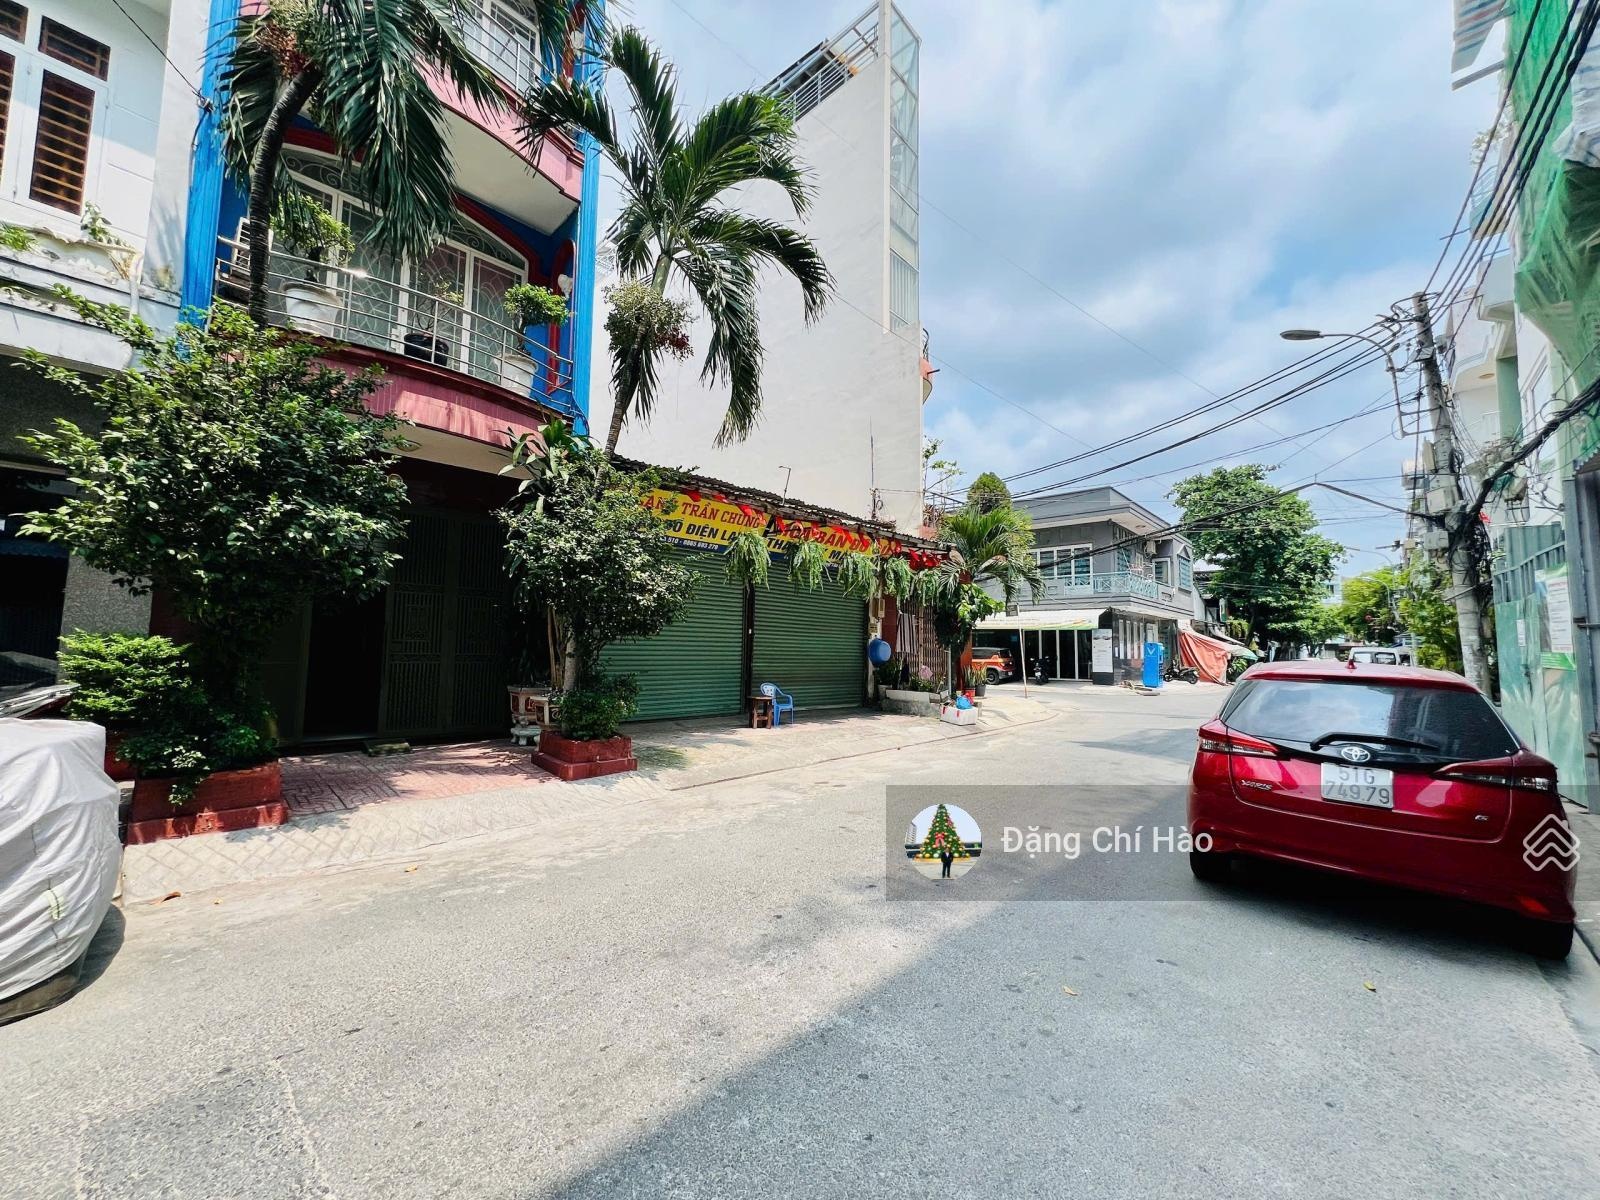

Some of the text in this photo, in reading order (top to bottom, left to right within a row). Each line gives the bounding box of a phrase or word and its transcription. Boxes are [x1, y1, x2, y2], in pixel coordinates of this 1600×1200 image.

[681, 502, 720, 521] TRẦN
[720, 510, 761, 529] CHUNG
[685, 523, 719, 540] ĐIỆN
[1339, 766, 1375, 785] 51G
[1325, 780, 1390, 805] 749.79
